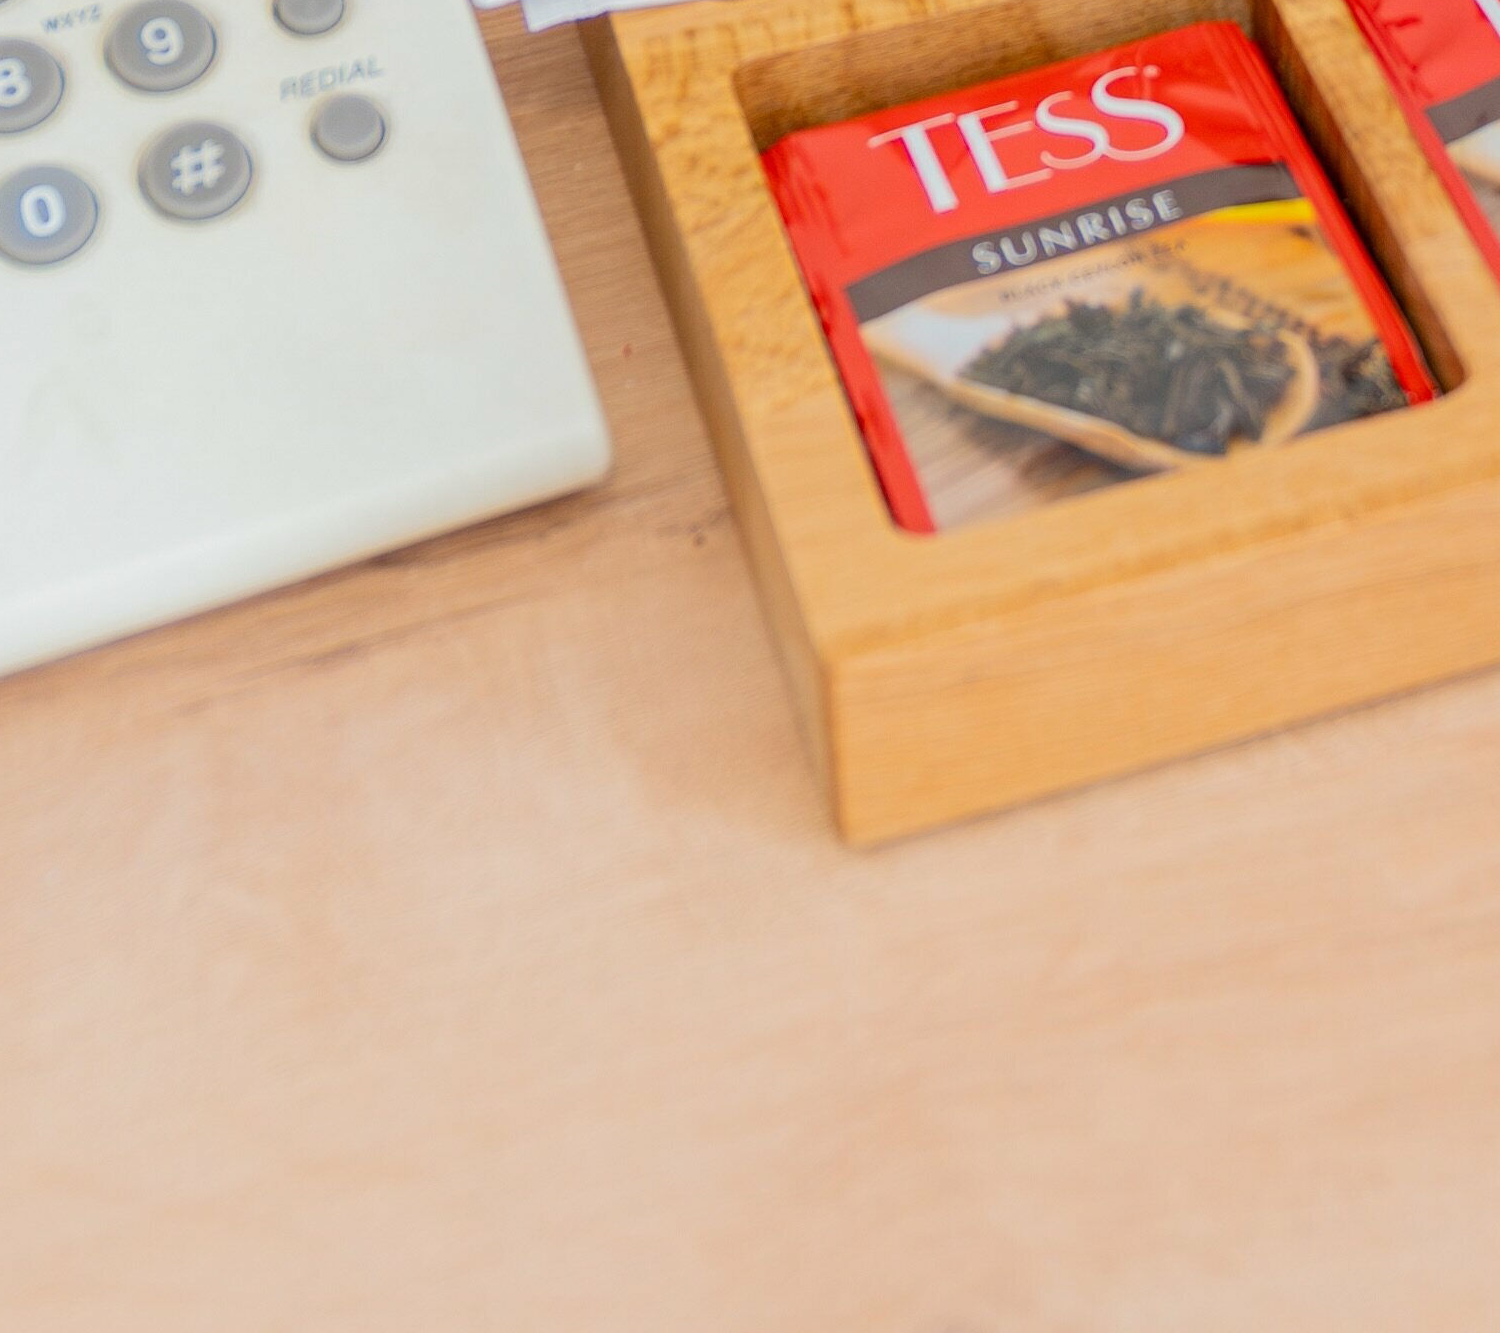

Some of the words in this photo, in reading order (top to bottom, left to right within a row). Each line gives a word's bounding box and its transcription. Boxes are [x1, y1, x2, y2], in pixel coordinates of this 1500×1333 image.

[138, 17, 185, 67] 9
[279, 56, 385, 102] REDIAL
[868, 64, 1186, 215] TESS
[19, 185, 66, 239] 0
[971, 189, 1185, 276] SUNRISE
